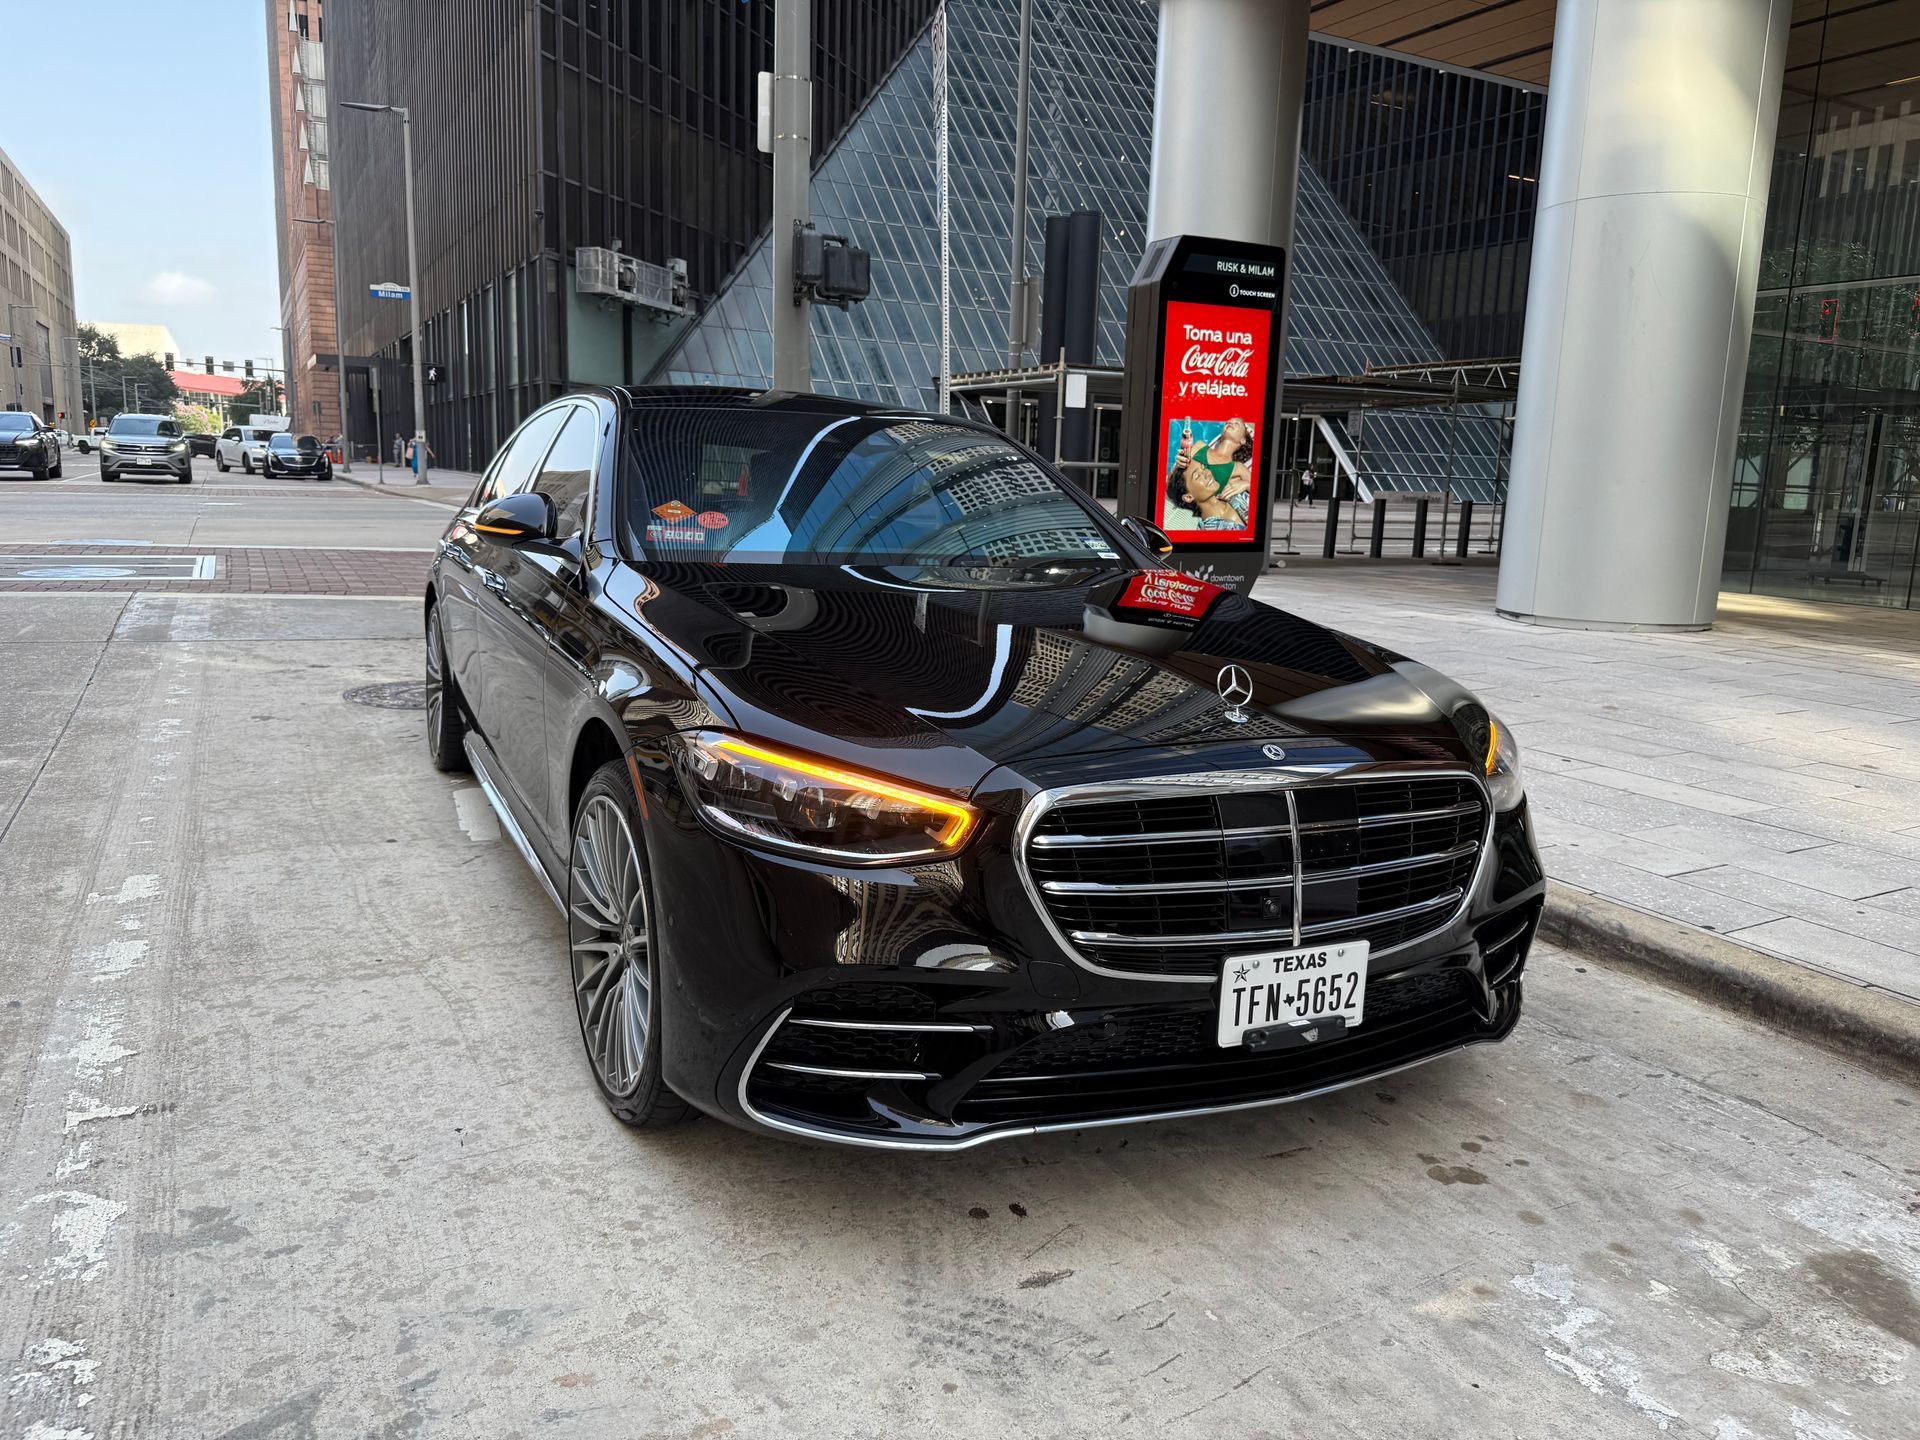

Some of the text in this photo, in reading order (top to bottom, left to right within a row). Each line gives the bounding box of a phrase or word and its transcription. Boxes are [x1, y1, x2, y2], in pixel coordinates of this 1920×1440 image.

[1216, 260, 1275, 277] RUSK & MILAM
[378, 290, 403, 299] Milam
[1239, 289, 1276, 299] TOUCH SCREEN
[1183, 324, 1253, 345] Toma una
[1181, 344, 1255, 378] Coca-Cola
[1178, 379, 1248, 399] y relájate.
[1210, 574, 1245, 583] downtown
[1273, 952, 1327, 974] TEXAS
